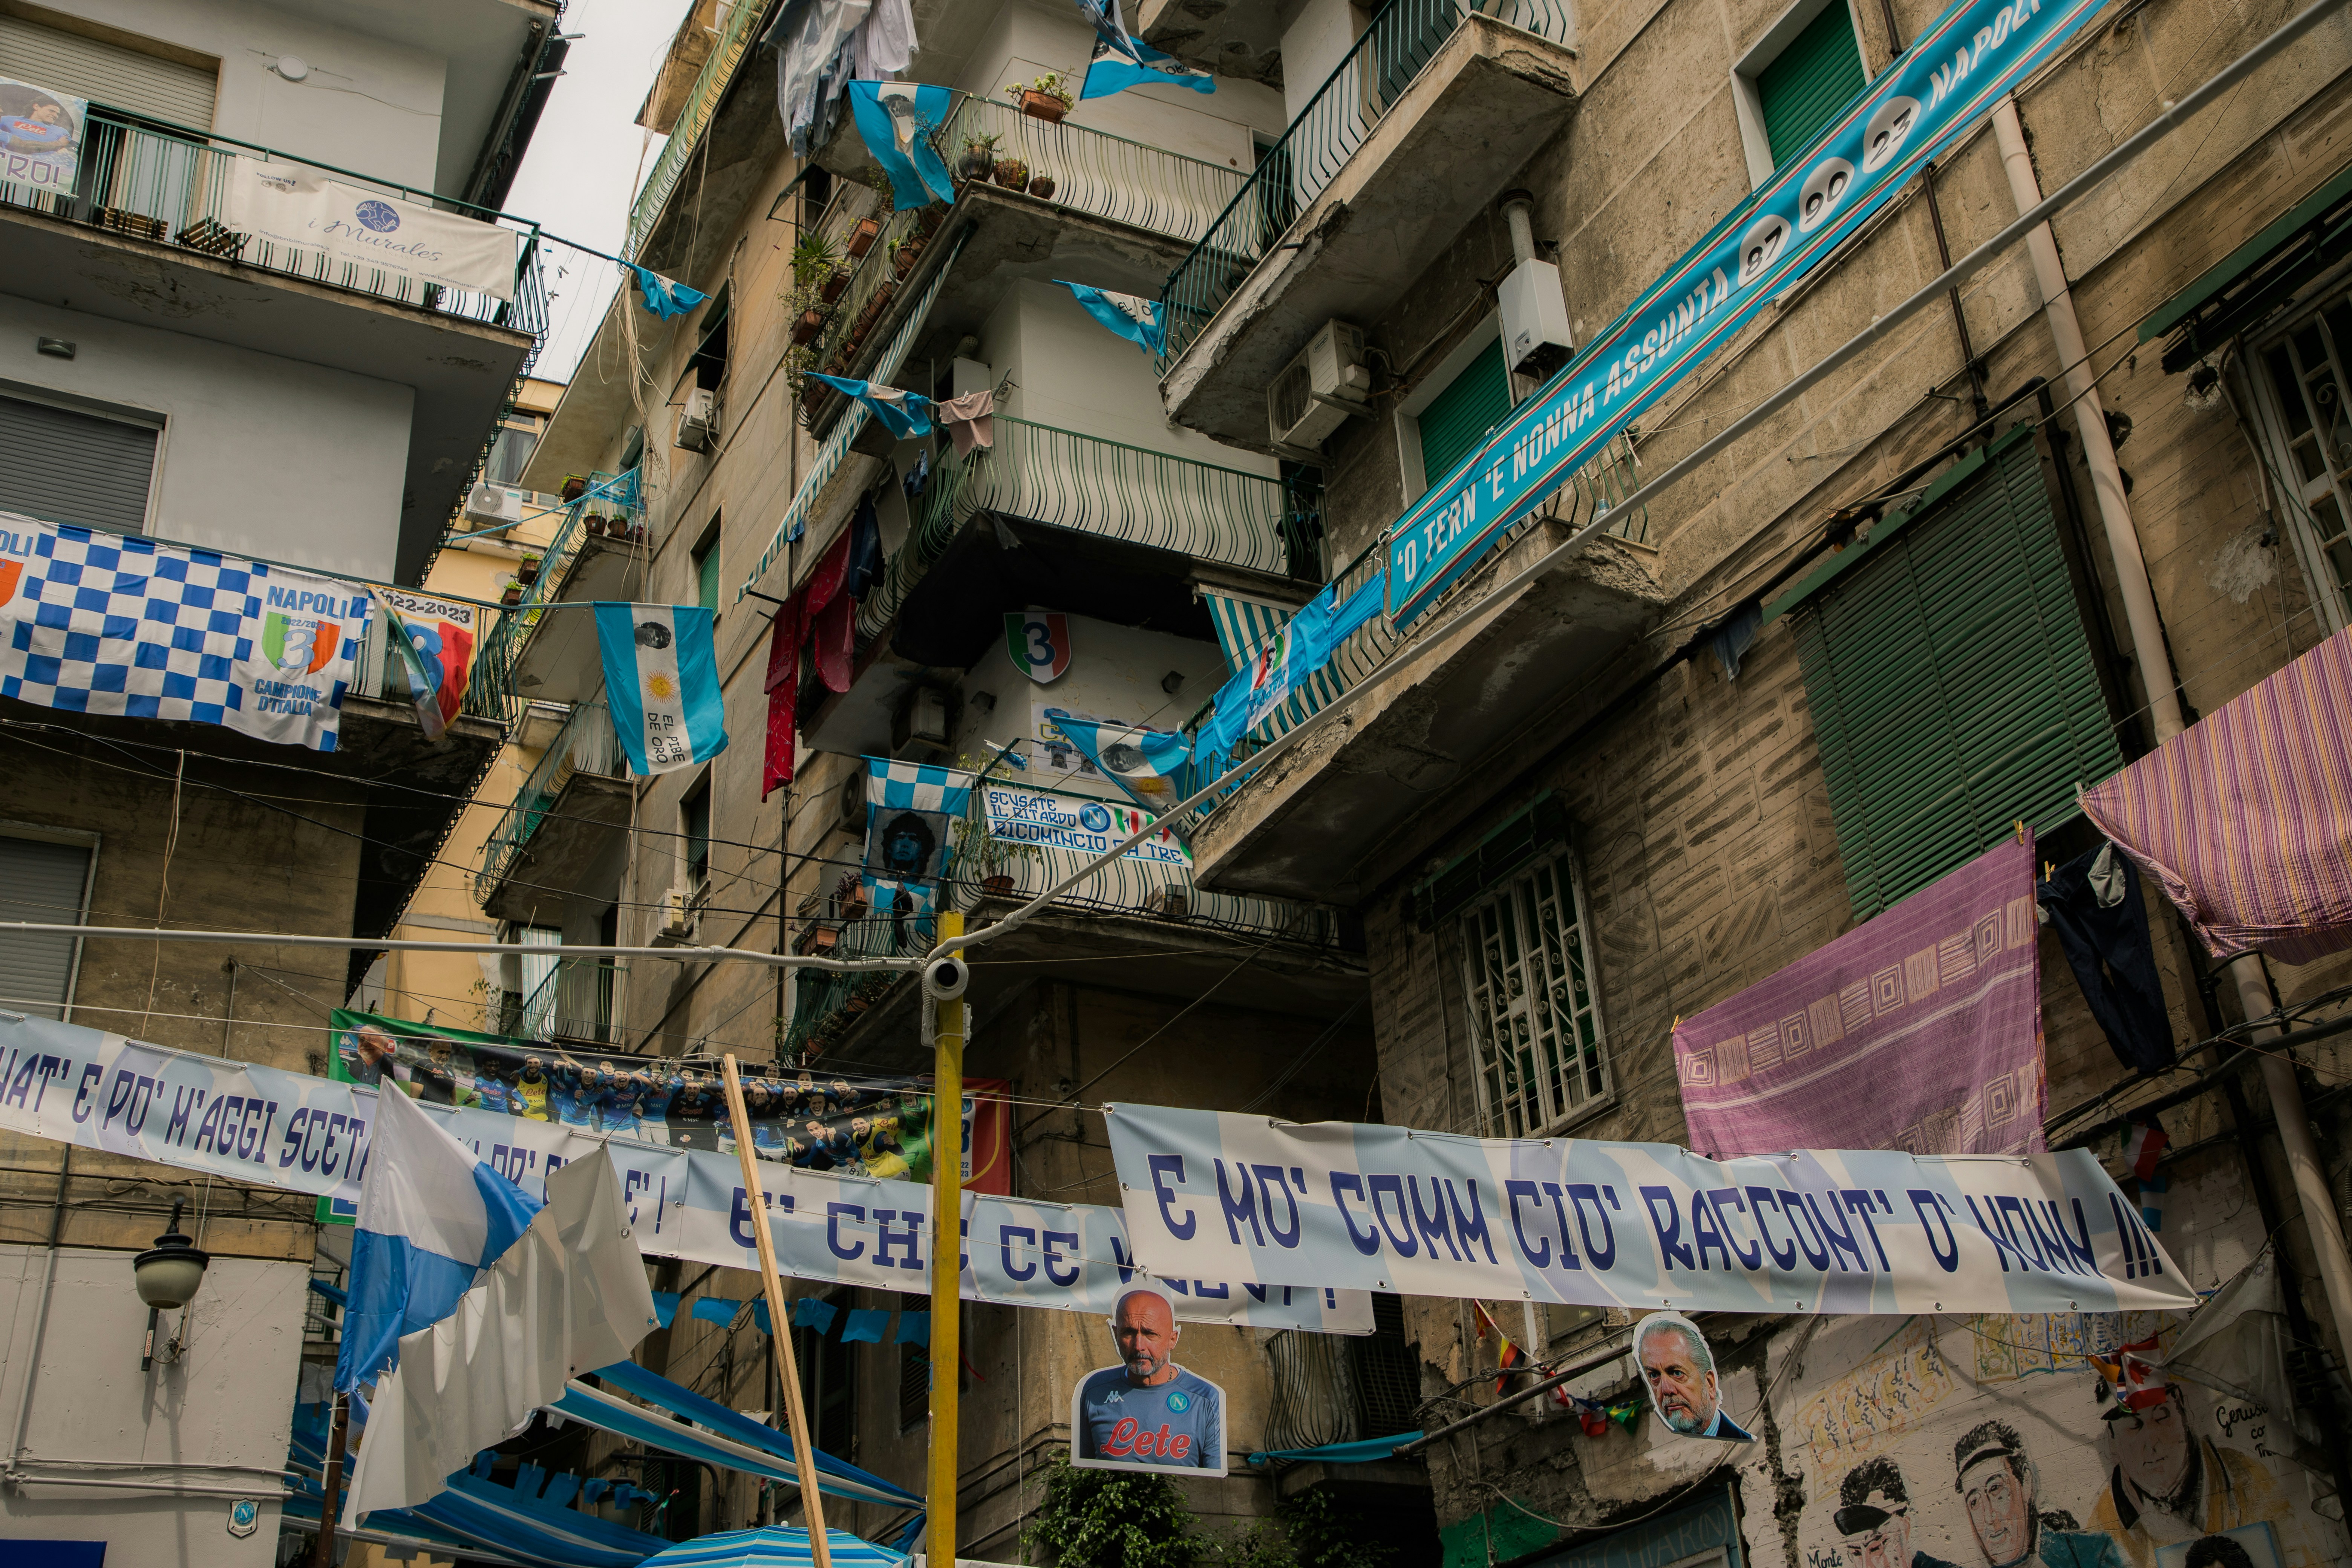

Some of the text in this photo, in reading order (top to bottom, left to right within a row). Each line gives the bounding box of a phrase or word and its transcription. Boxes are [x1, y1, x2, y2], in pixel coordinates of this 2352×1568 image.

[256, 172, 282, 181] FOLLOW
[259, 229, 330, 251] info@bnbimurales.it
[323, 219, 443, 261] Murales
[418, 271, 485, 290] www.bnbimurales.it
[1423, 483, 1476, 564] TERN
[1512, 381, 1595, 484] NONNA
[1603, 266, 1729, 407] ASSUNTA
[1744, 225, 1783, 277] 87
[1804, 170, 1848, 225] 90
[1869, 106, 1912, 166] 23
[267, 585, 348, 620] NAPOLI
[379, 591, 470, 624] 022-2023
[281, 616, 325, 631] 2022/2023
[276, 629, 317, 669] 3
[1021, 622, 1057, 666] 3
[254, 678, 322, 704] CAMPIONE
[257, 697, 312, 716] D'ITALIA
[648, 712, 668, 764] DE ORO
[663, 714, 686, 762] EL PIBE
[991, 804, 1008, 817] IL
[994, 820, 1107, 851] RICOMINCIO
[1146, 842, 1183, 862] TRE
[524, 1088, 545, 1096] Lete
[72, 1062, 104, 1124] E
[101, 1069, 165, 1137] PO'
[163, 1084, 279, 1165] M'AGGI
[1146, 1153, 1197, 1241] E
[1211, 1155, 1308, 1250] MO'
[1328, 1170, 1500, 1266] COMM
[1503, 1178, 1623, 1272] CIO'
[1637, 1184, 1894, 1274] RACCONT'
[826, 1201, 969, 1274] CH
[999, 1223, 1081, 1288] CE
[1099, 1416, 1191, 1459] Lete
